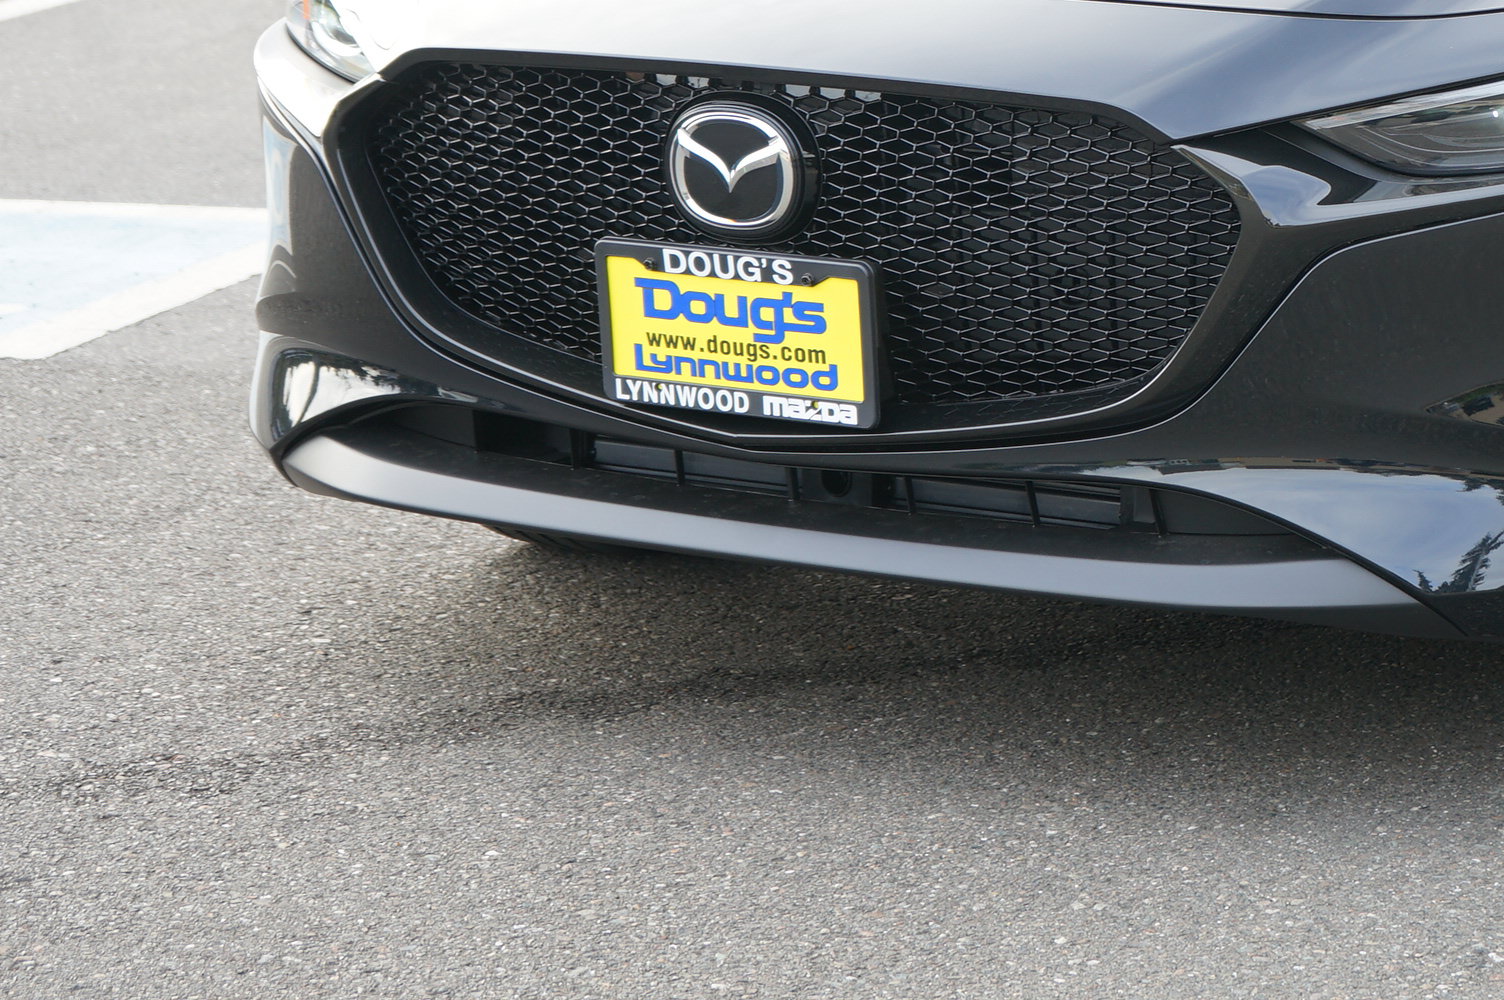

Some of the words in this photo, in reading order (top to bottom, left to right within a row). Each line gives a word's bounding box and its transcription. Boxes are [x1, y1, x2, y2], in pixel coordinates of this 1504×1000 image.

[662, 249, 794, 285] DOUG'S
[634, 277, 828, 344] Doug's
[646, 332, 827, 364] www.dougs.com
[634, 343, 838, 392] Lynnwood
[615, 378, 750, 414] LYNNWOOD
